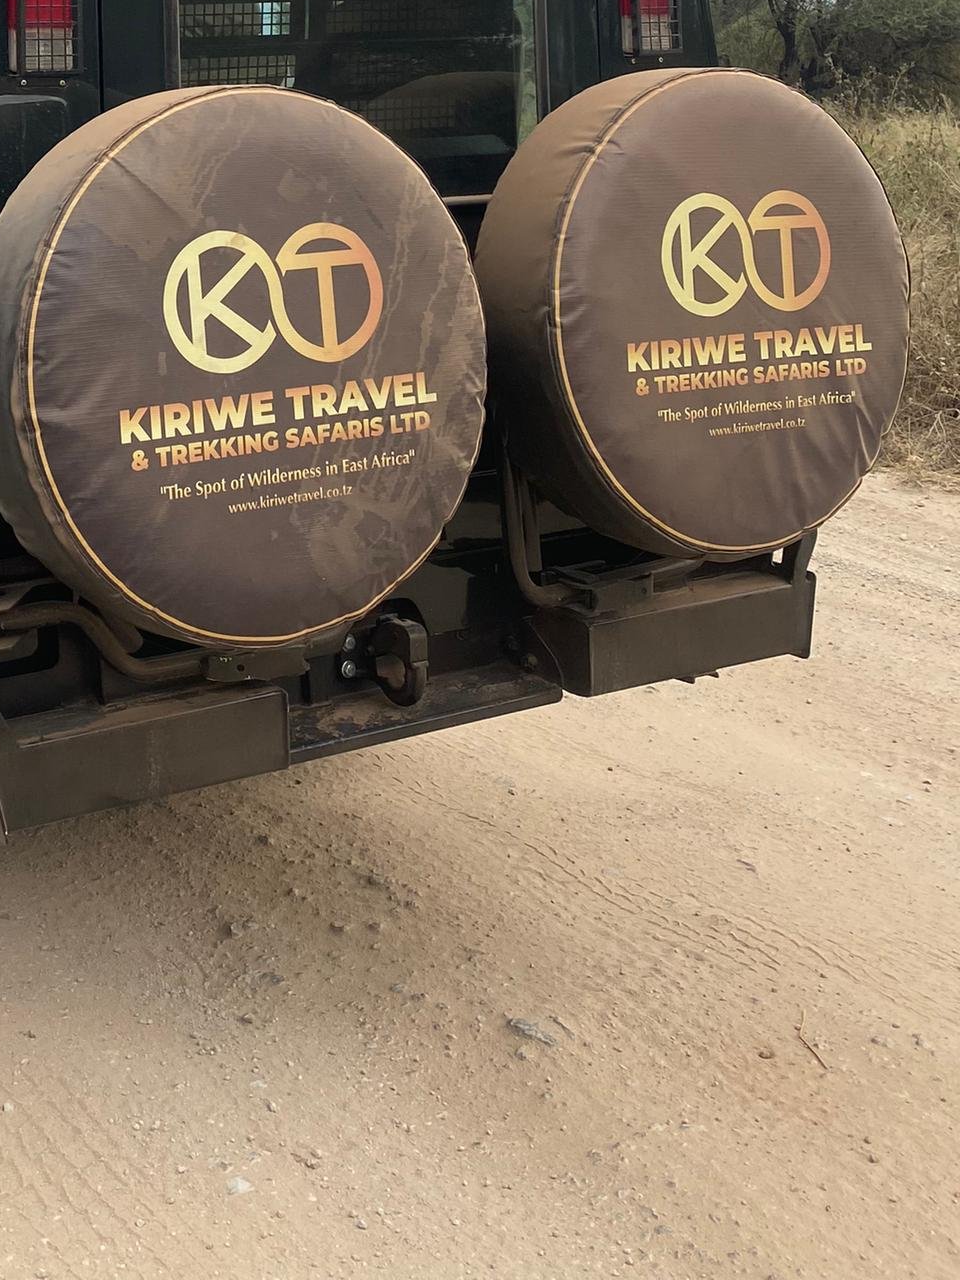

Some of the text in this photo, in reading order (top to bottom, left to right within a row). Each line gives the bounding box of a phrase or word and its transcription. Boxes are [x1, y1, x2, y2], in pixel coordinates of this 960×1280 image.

[627, 324, 873, 372] KIRIWE TRAVEL
[635, 357, 867, 396] & TREKKING SAFARIS LTD
[118, 371, 438, 444] KIRIWE TRAVEL
[684, 405, 709, 423] Spot
[711, 401, 724, 418] of
[724, 398, 783, 417] Wilderness
[785, 395, 796, 410] in
[798, 392, 817, 408] East
[709, 417, 806, 437] www.kiriwetravel.co.tz
[131, 410, 431, 472] & TREKKING SAFARIS LTD
[195, 478, 227, 499] Spot
[229, 473, 246, 490] of
[247, 465, 322, 487] Wilderness
[325, 460, 339, 476] in
[342, 456, 368, 473] East
[228, 485, 352, 514] www.kiriwetravel.co.tz
